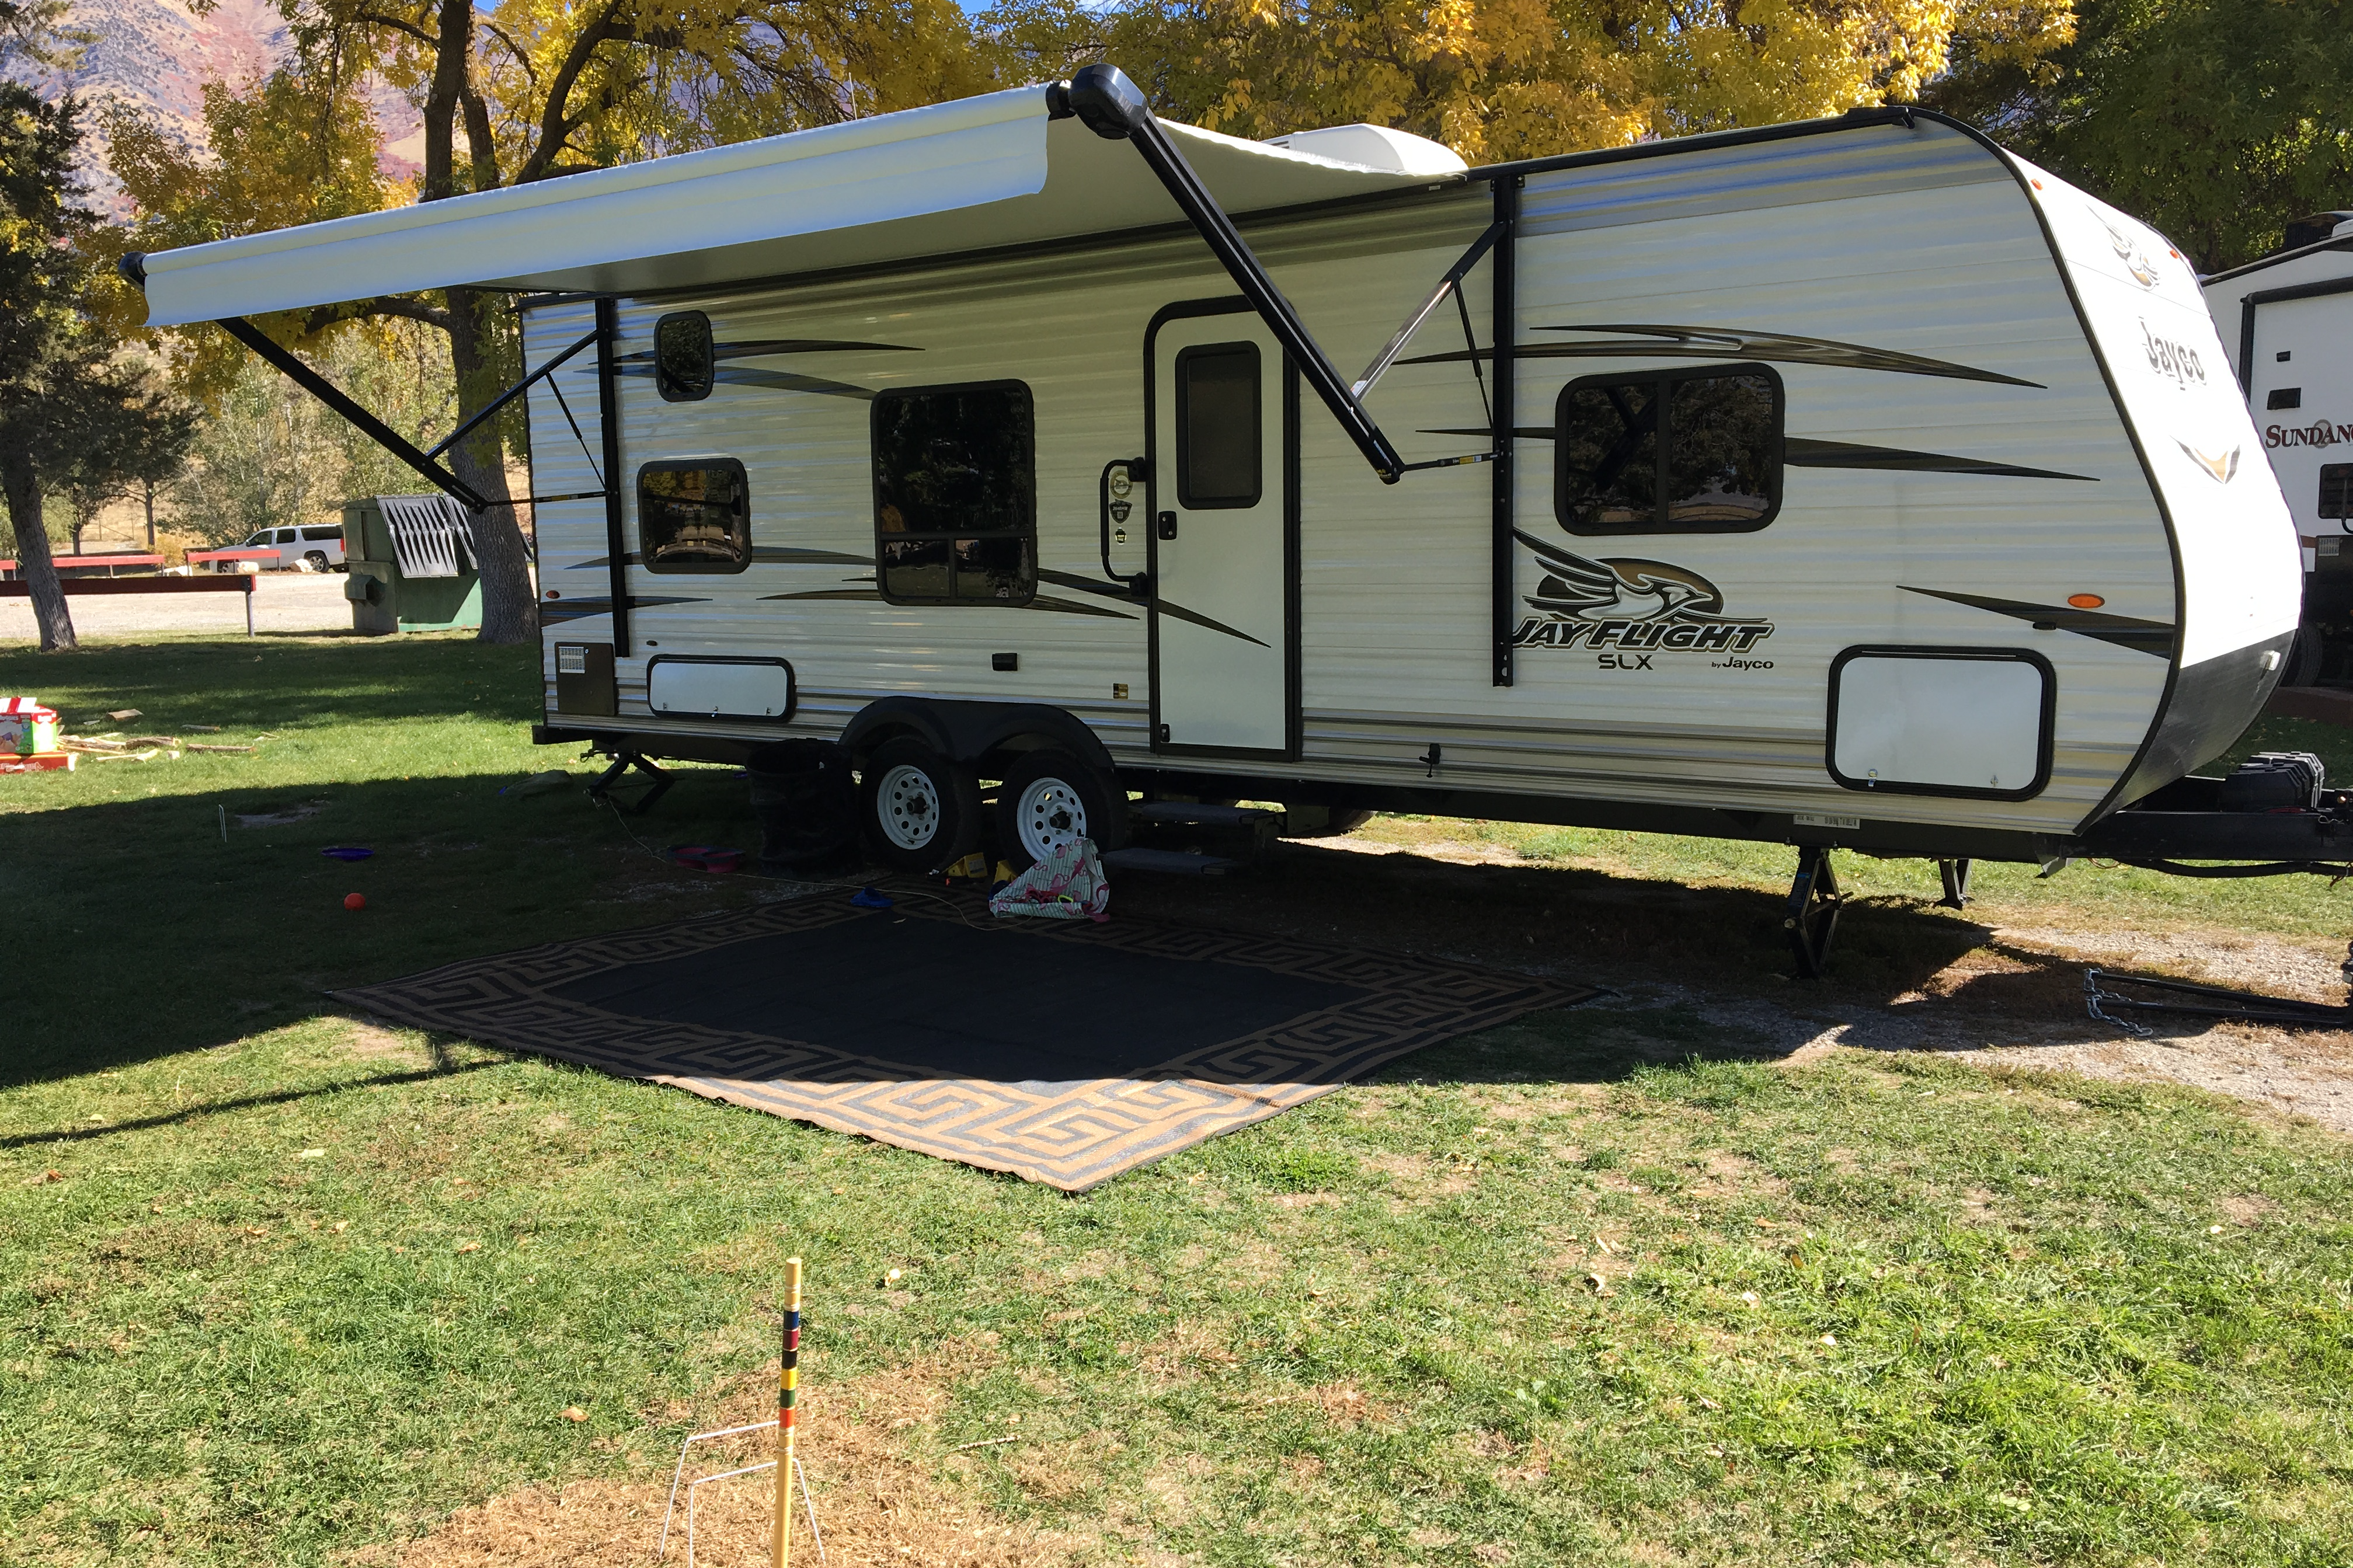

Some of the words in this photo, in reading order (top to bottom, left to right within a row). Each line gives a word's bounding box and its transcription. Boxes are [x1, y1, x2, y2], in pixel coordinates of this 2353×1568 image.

[2138, 316, 2207, 391] Jayco
[2265, 424, 2353, 449] SUNDAN
[1512, 617, 1593, 649] JAY
[1585, 618, 1775, 653] FLIGHT
[1597, 654, 1654, 670] SLX
[1722, 656, 1774, 671] Jayco
